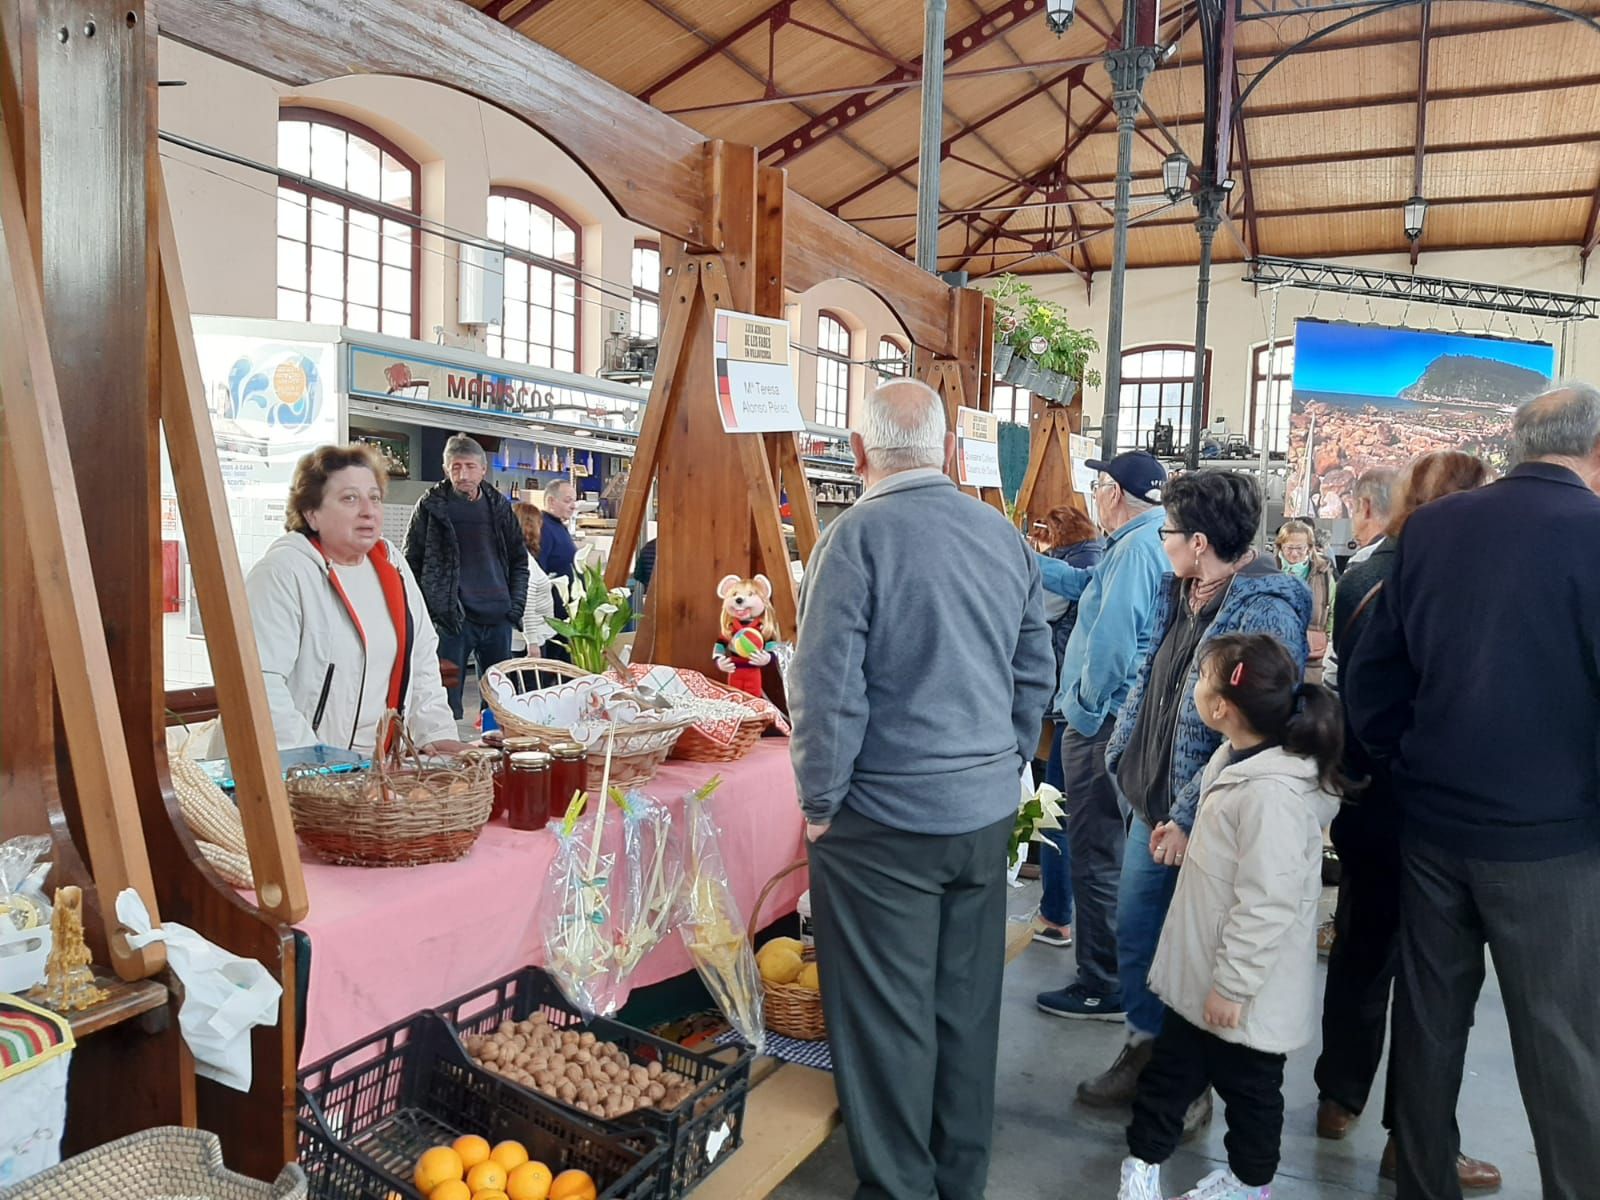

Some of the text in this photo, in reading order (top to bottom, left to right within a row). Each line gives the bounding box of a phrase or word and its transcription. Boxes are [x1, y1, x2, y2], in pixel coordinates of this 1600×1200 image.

[758, 336, 771, 349] FABES
[447, 373, 554, 412] MARISCOS
[755, 382, 780, 395] Teresa
[742, 400, 767, 413] Alonso
